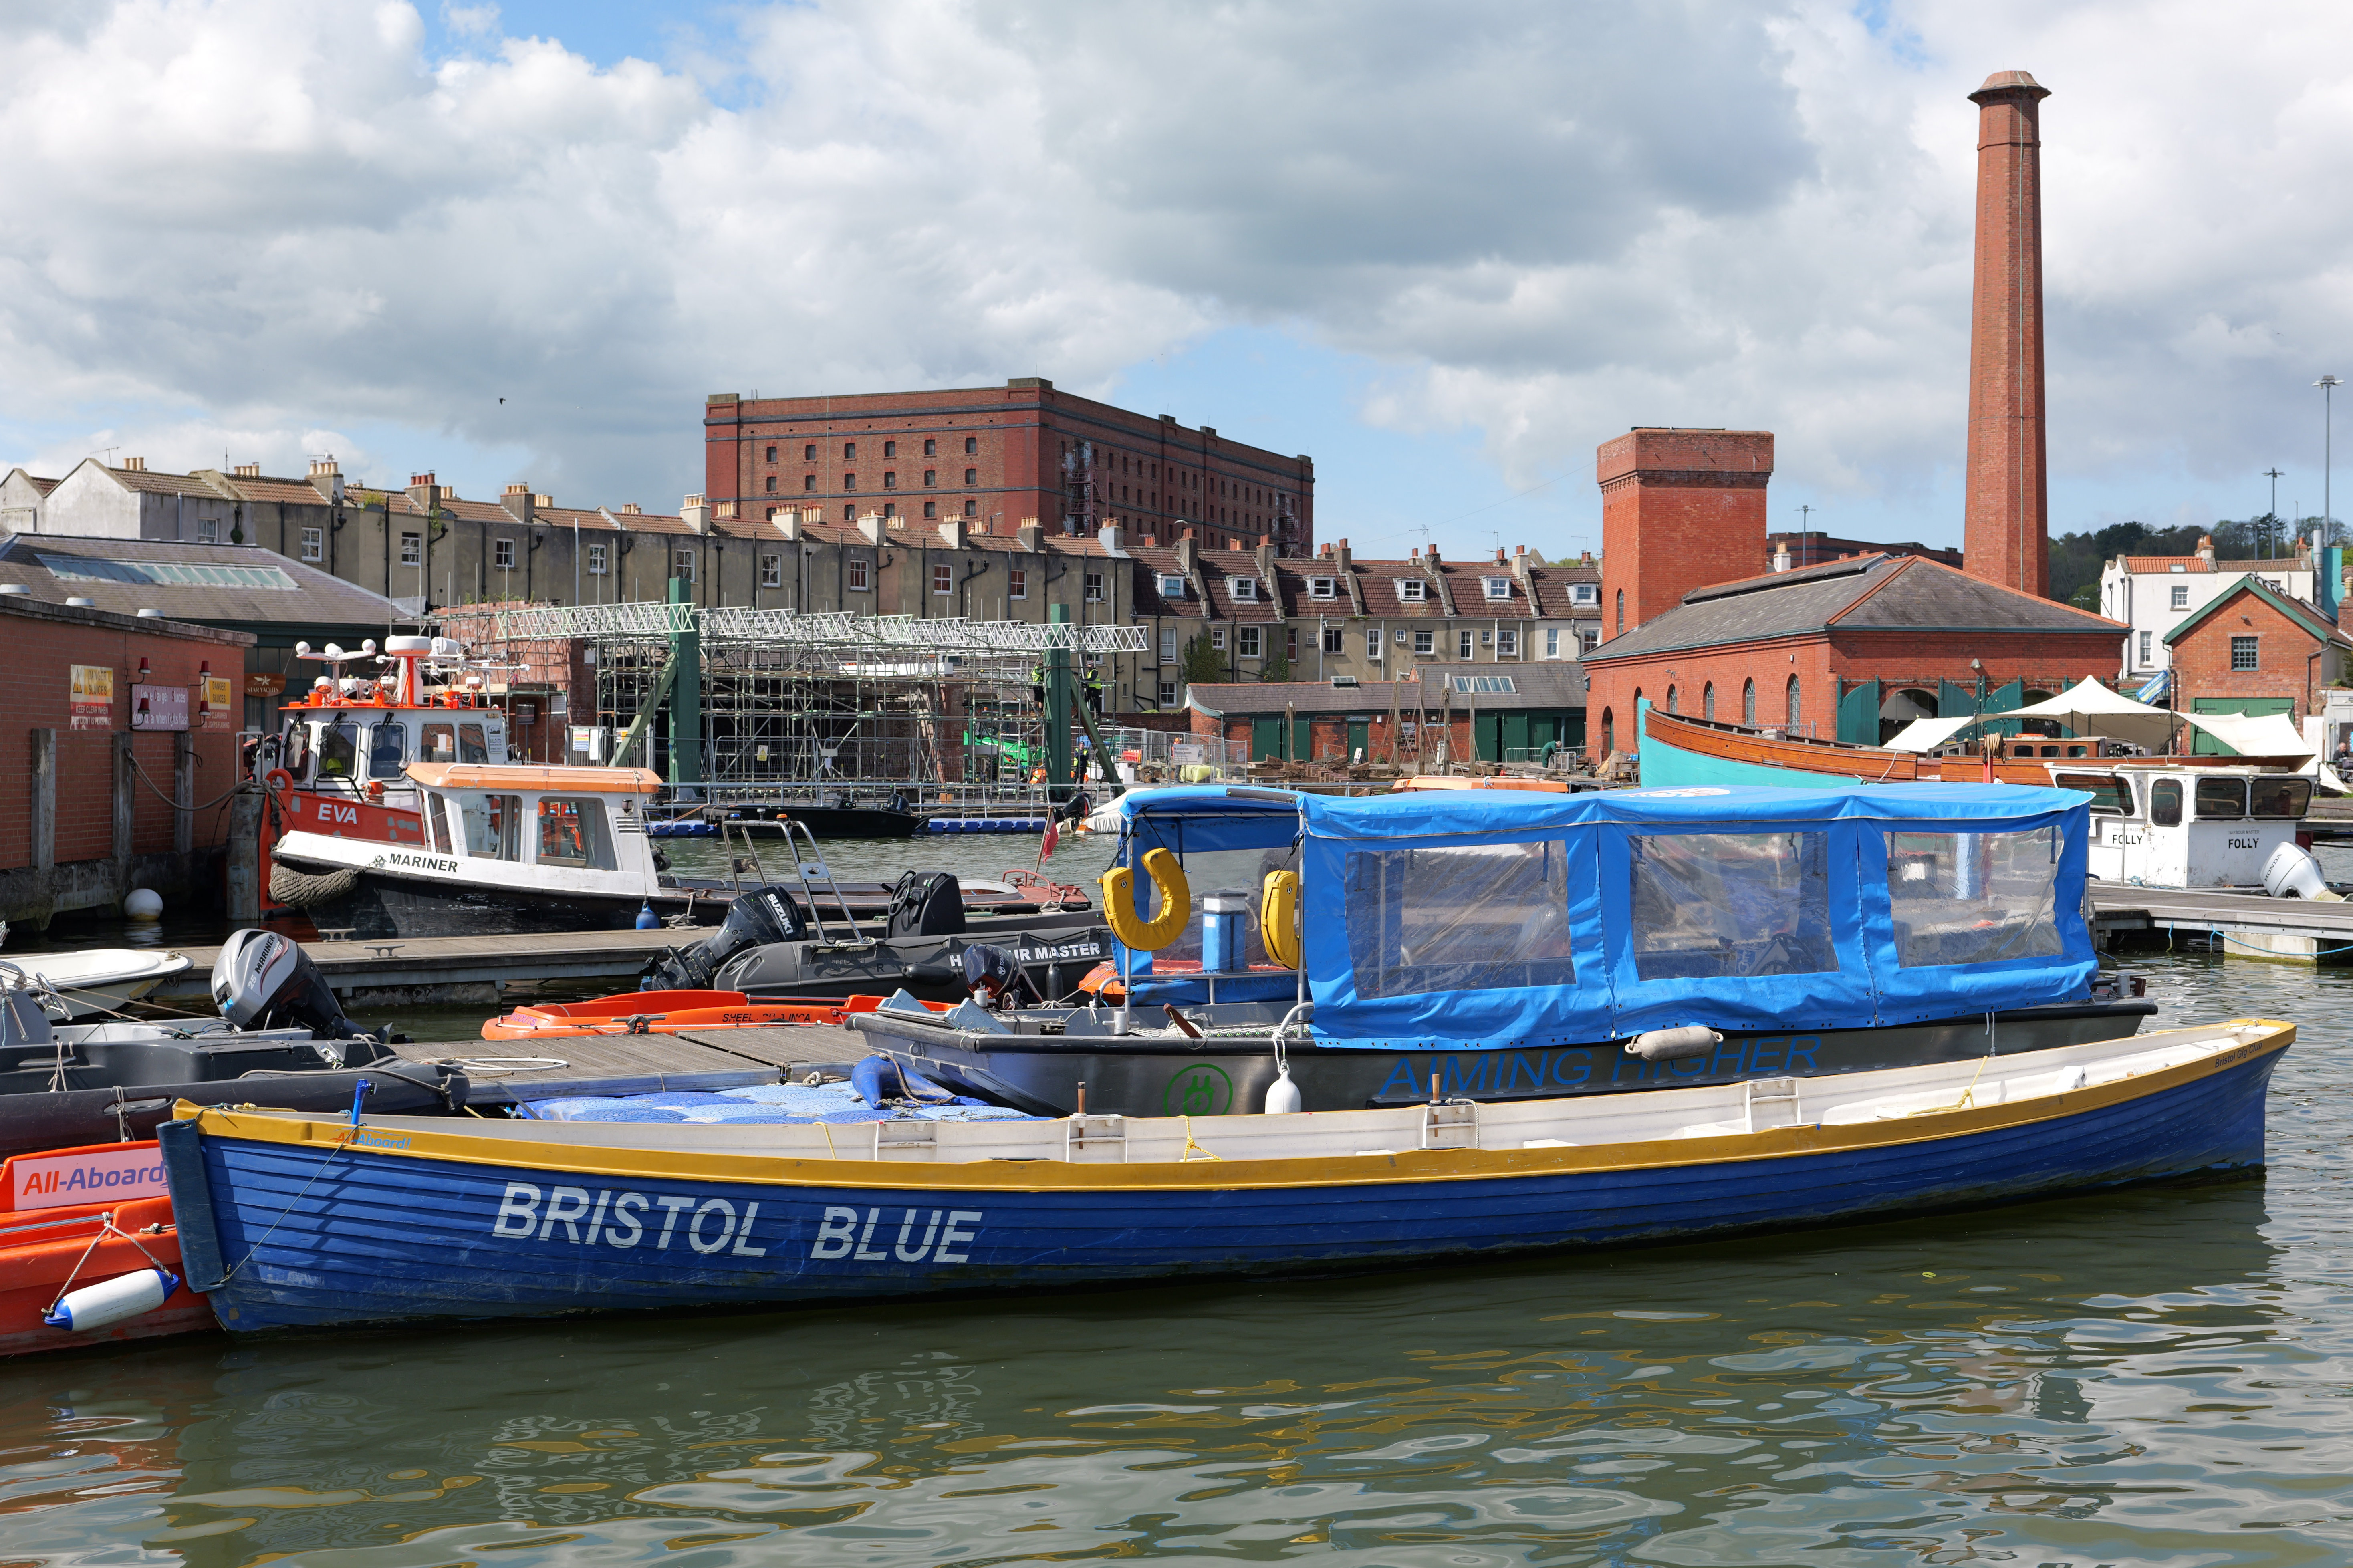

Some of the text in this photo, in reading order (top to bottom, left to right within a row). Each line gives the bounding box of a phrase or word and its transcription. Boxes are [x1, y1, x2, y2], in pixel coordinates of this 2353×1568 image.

[89, 671, 106, 681] DANGER
[89, 685, 107, 695] SLUICES
[212, 681, 226, 691] DANGER
[172, 690, 185, 703] Sluices
[212, 694, 226, 703] SLUICES
[98, 707, 108, 715] WHEN
[156, 712, 167, 724] when
[179, 713, 189, 725] flash
[71, 716, 80, 724] RED
[95, 717, 111, 726] FLASHING
[318, 803, 357, 824] EVA
[2113, 834, 2143, 845] FOLLY
[2229, 838, 2259, 848] FOLLY
[389, 853, 458, 873] MARINER
[2264, 854, 2282, 882] HONDA
[767, 893, 794, 935] SUZUKI
[254, 935, 275, 974] MARINER
[1035, 943, 1101, 960] MASTER
[248, 974, 257, 990] 25
[2215, 1042, 2262, 1068] Bristol Gig Club
[1379, 1049, 1593, 1096] AIMING
[22, 1161, 168, 1195] All-Aboard
[492, 1181, 982, 1263] BRISTOL BLUE
